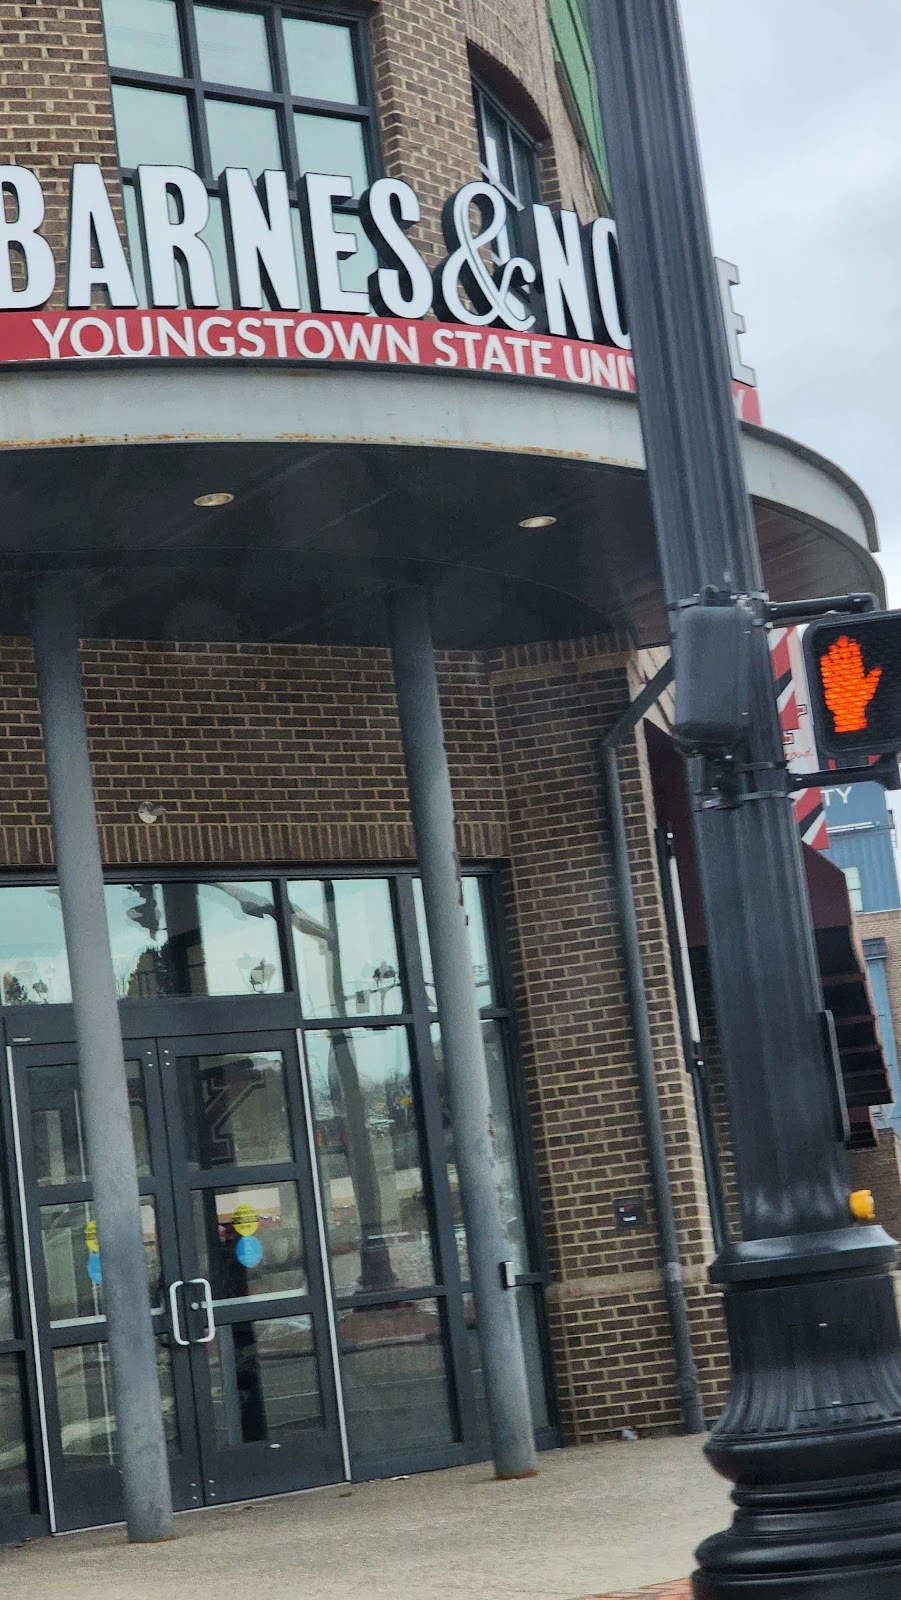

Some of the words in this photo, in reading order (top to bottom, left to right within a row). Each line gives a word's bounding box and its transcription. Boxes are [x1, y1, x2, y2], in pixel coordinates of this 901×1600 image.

[0, 163, 434, 319] BARNES
[438, 181, 536, 332] &
[32, 316, 420, 365] YOUNGSTOWN
[432, 328, 556, 379] STATE
